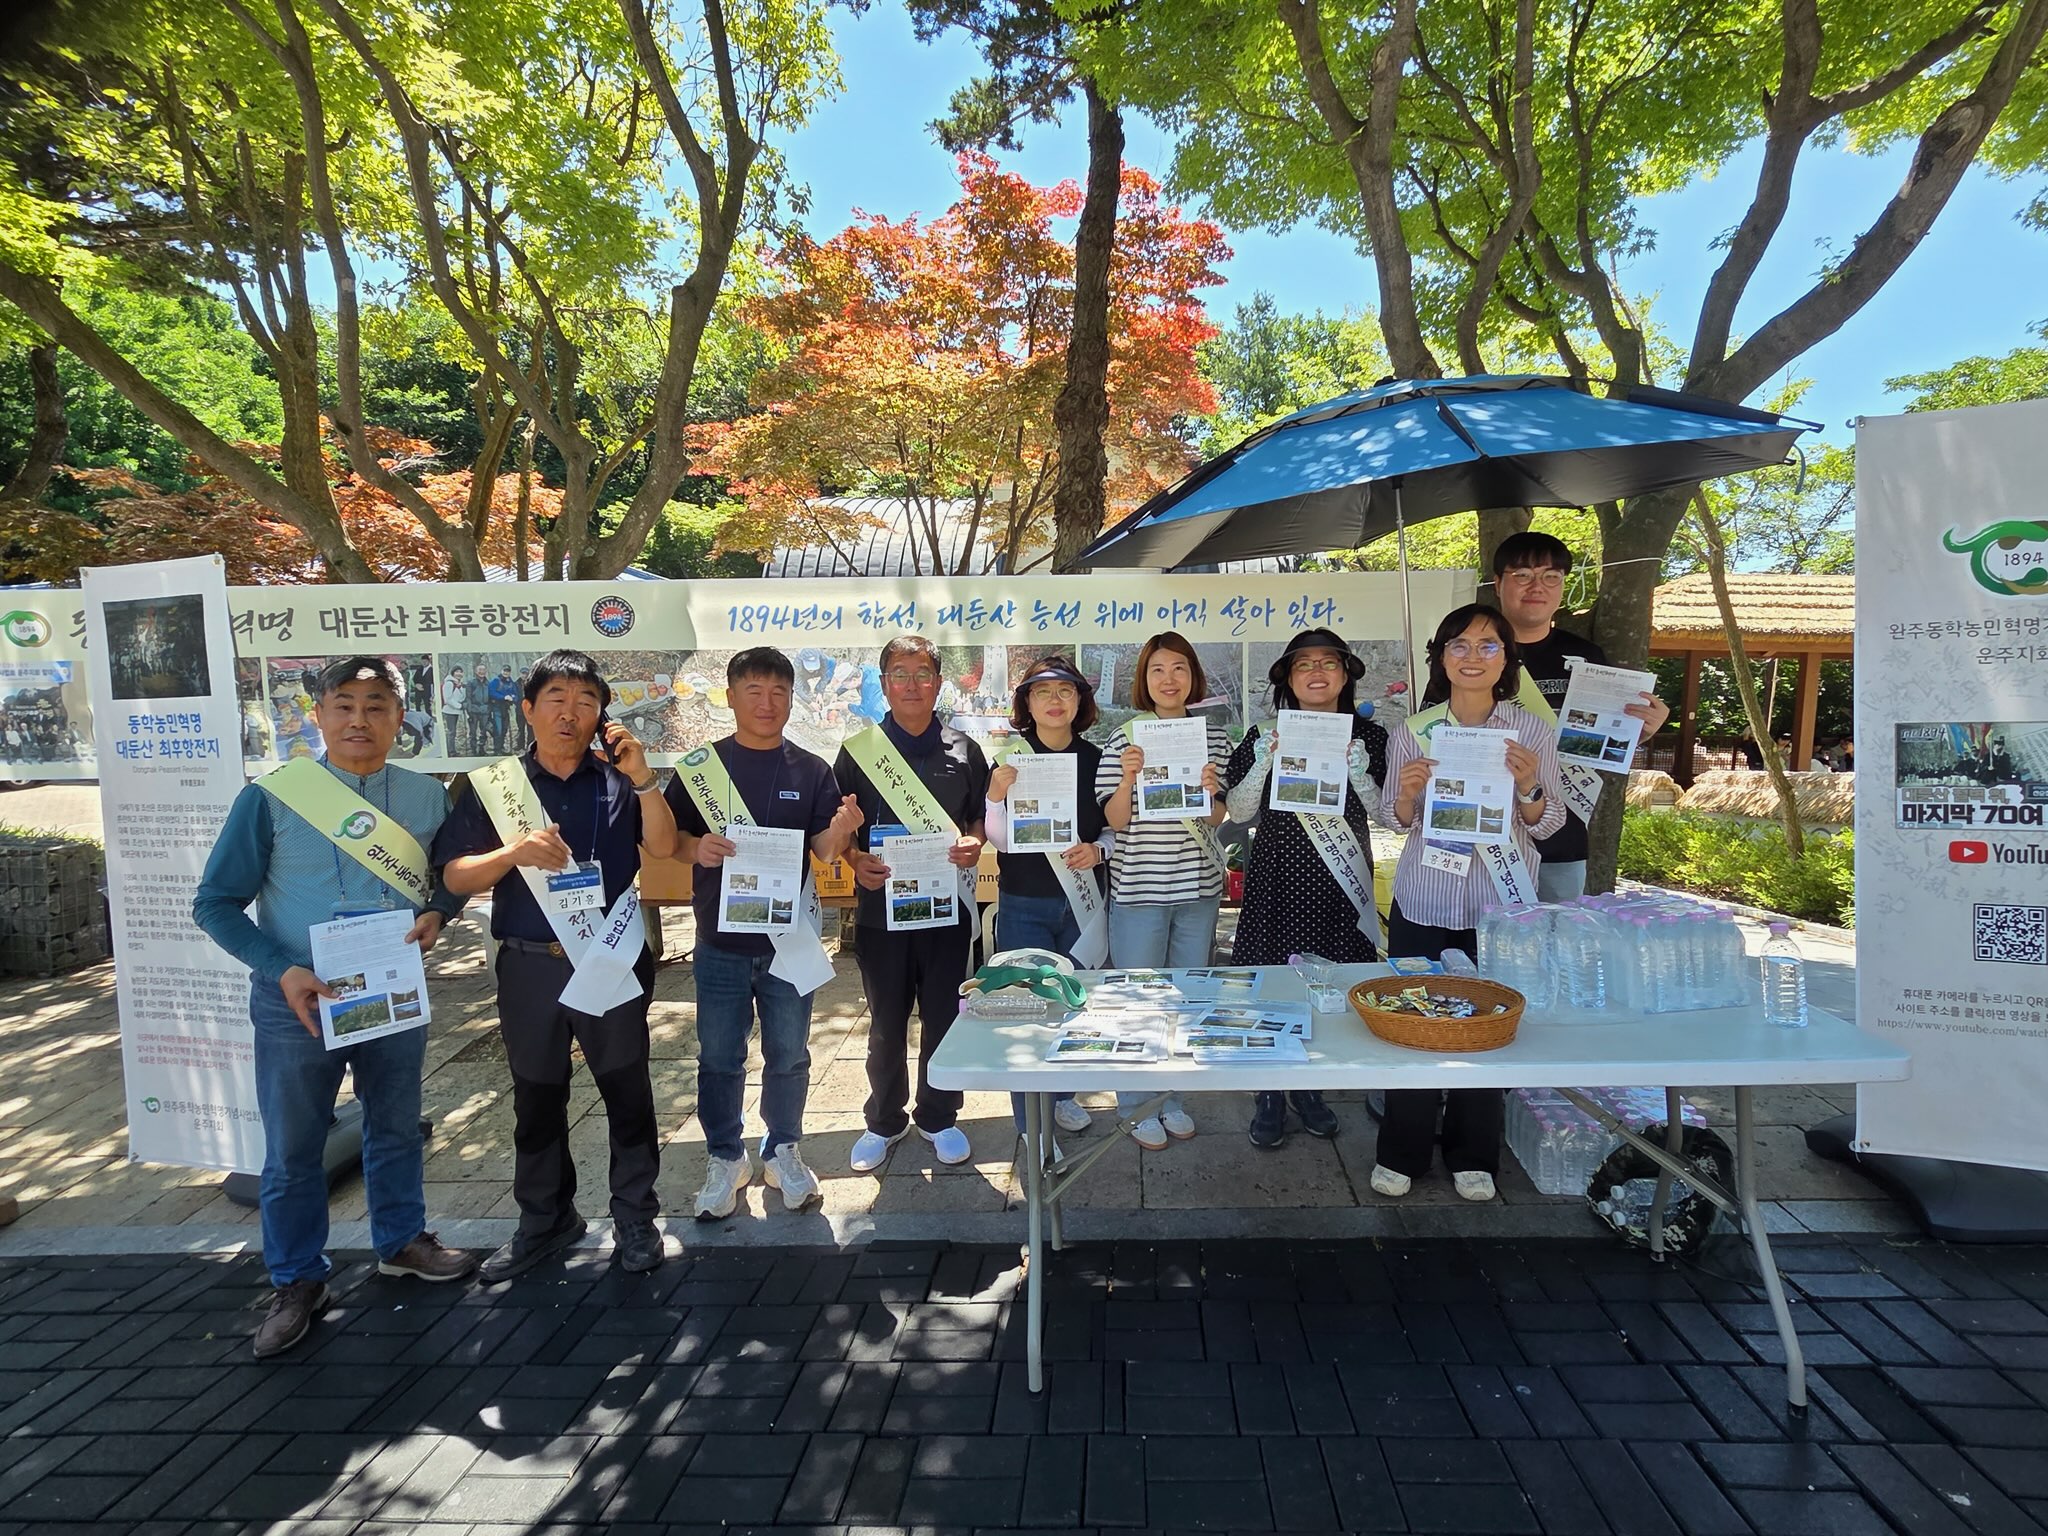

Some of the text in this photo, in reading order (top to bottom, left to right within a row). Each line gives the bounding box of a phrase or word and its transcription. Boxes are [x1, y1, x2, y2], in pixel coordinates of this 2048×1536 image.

[2005, 552, 2044, 566] 1894
[319, 605, 410, 638] 대둔산
[418, 603, 570, 637] 최후항전지
[727, 595, 1344, 636] 1894년의 함성, 대둔산 능선 위에 아직 살아 있다.
[128, 713, 202, 734] 동학농민혁명
[116, 738, 219, 759] 대둔산 최후항전지
[1902, 803, 2044, 825] 마지막 70여
[1903, 989, 1933, 1000] 휴대폰
[1936, 990, 1978, 1003] 카메라를
[1982, 993, 2024, 1005] 누르시고
[1895, 1003, 2041, 1023] 사이트 주소를 클릭하면 영상을
